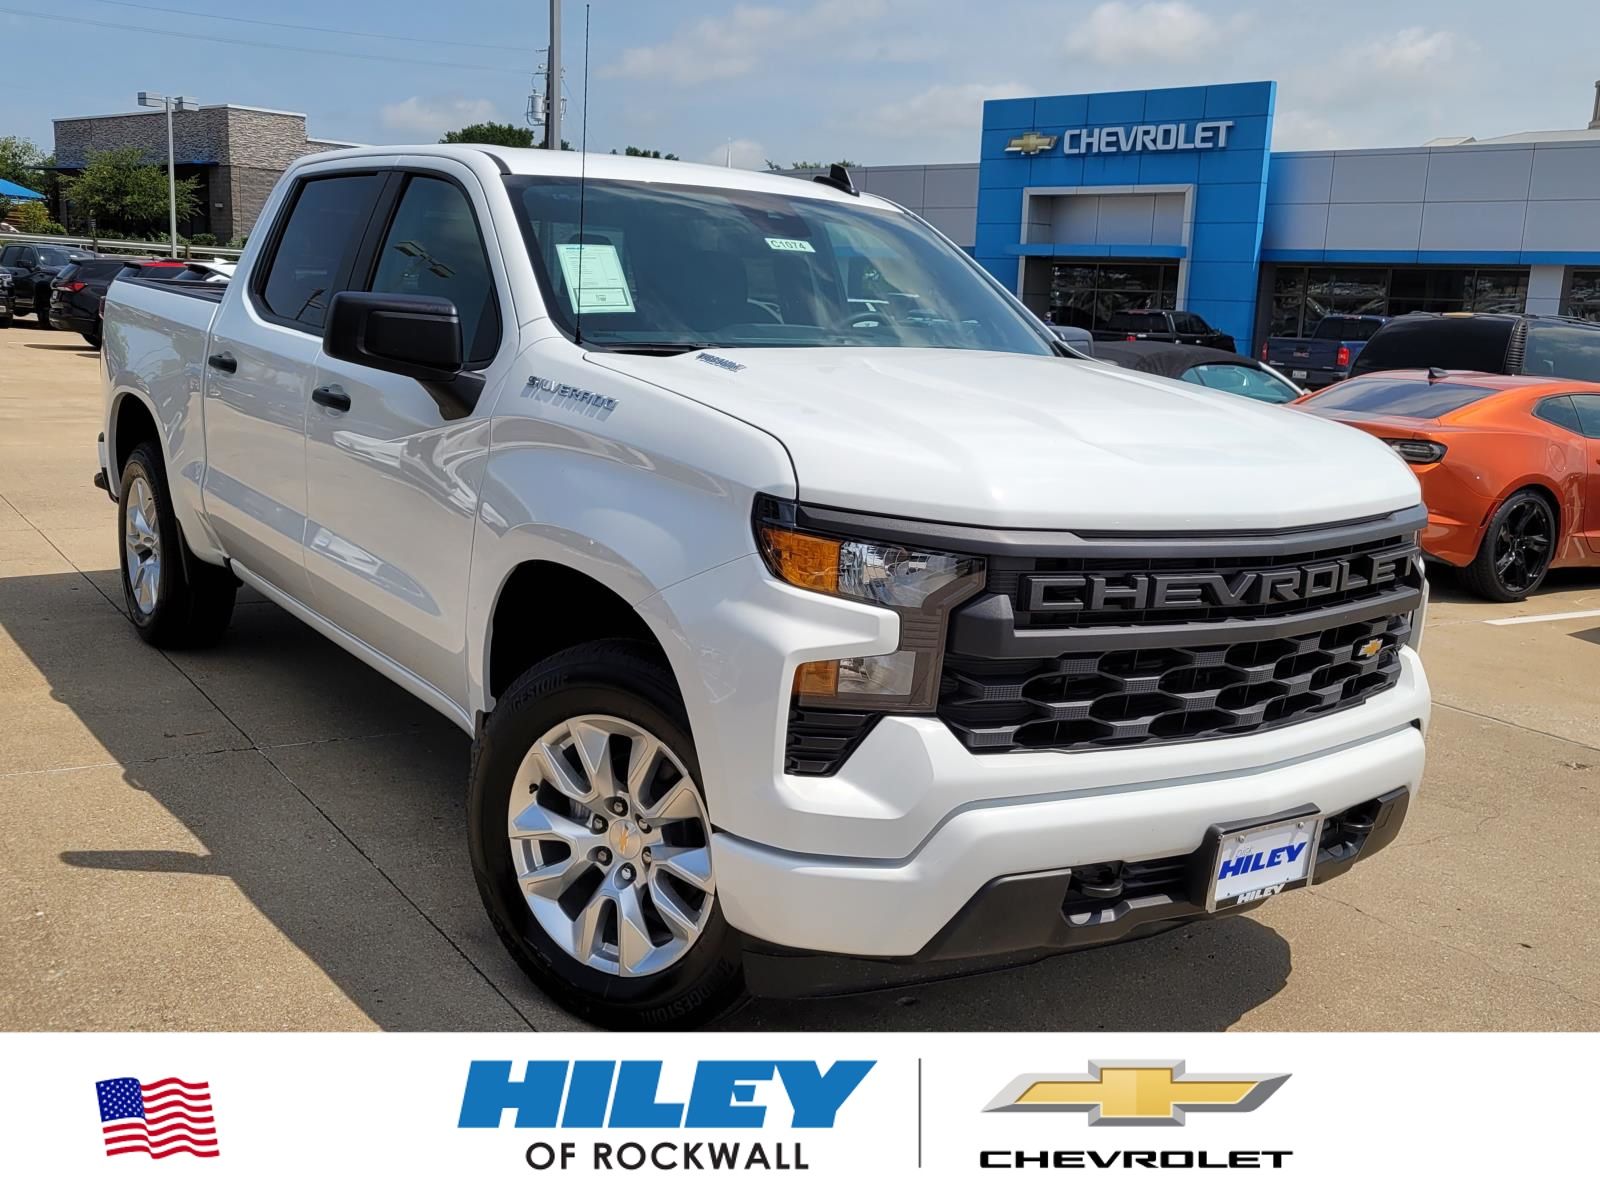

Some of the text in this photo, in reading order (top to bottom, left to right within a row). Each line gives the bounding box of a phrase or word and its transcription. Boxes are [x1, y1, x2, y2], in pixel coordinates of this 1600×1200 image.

[1063, 120, 1234, 155] CHEVROLET
[770, 239, 807, 250] C1074
[527, 375, 619, 411] SILVERADO
[1026, 547, 1420, 611] CHEVROLET
[1218, 841, 1307, 880] HILEY
[1236, 882, 1286, 905] HILEY
